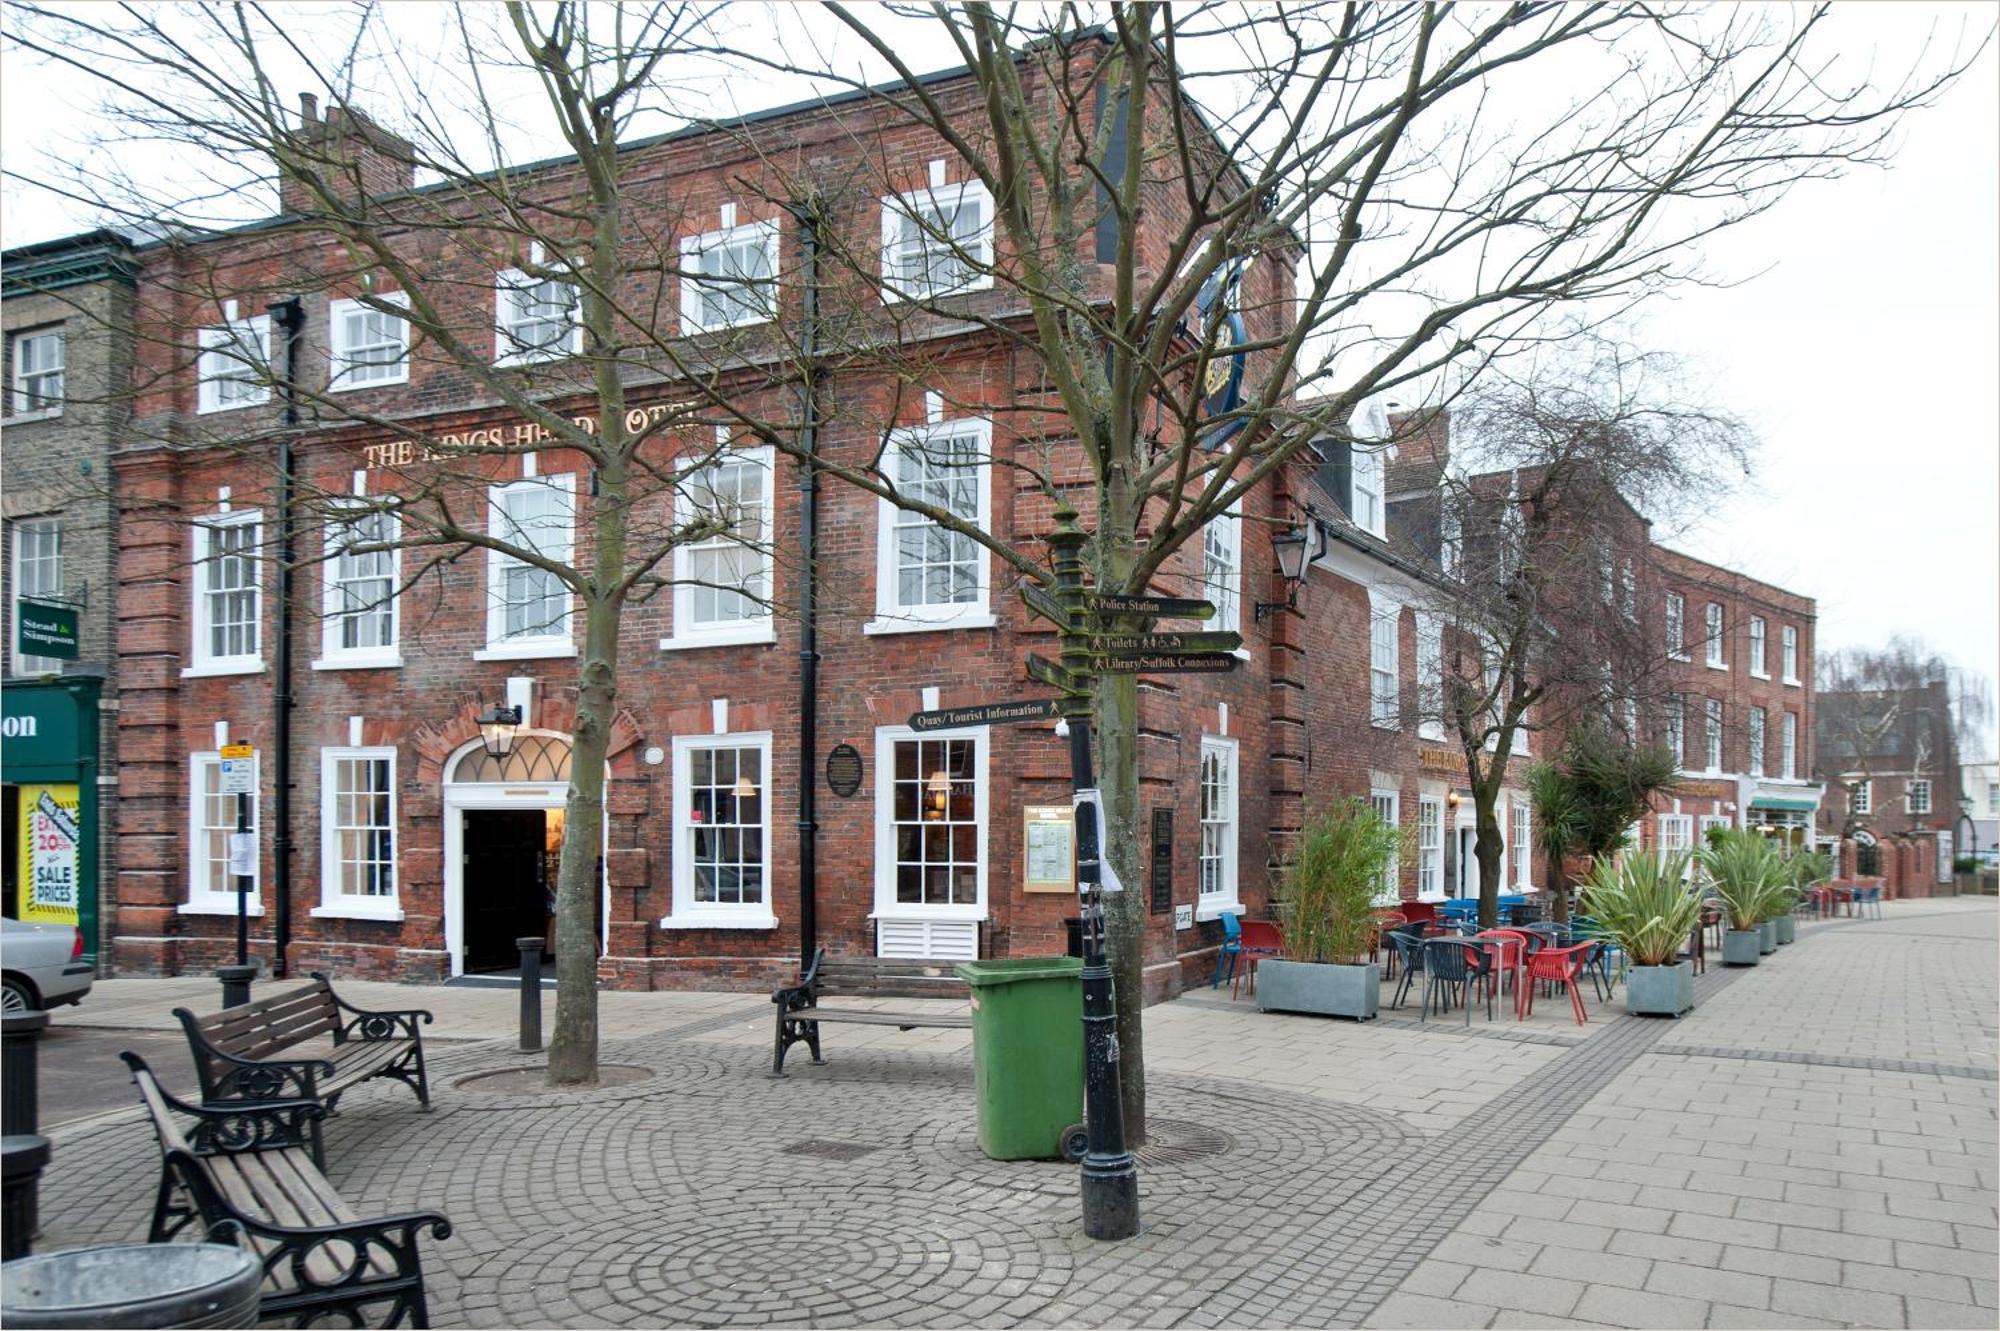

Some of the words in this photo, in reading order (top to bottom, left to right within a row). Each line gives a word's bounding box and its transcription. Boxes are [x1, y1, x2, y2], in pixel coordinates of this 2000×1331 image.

[364, 441, 413, 469] THE
[513, 417, 594, 446] HED
[1100, 600, 1128, 610] Police
[1131, 601, 1160, 612] Station
[23, 619, 58, 632] Stead
[23, 630, 75, 645] Simpson
[1106, 635, 1138, 649] Toilets
[1178, 658, 1229, 668] Connexions
[987, 704, 1044, 719] Information
[38, 866, 71, 883] SALE
[38, 885, 71, 902] PRICES
